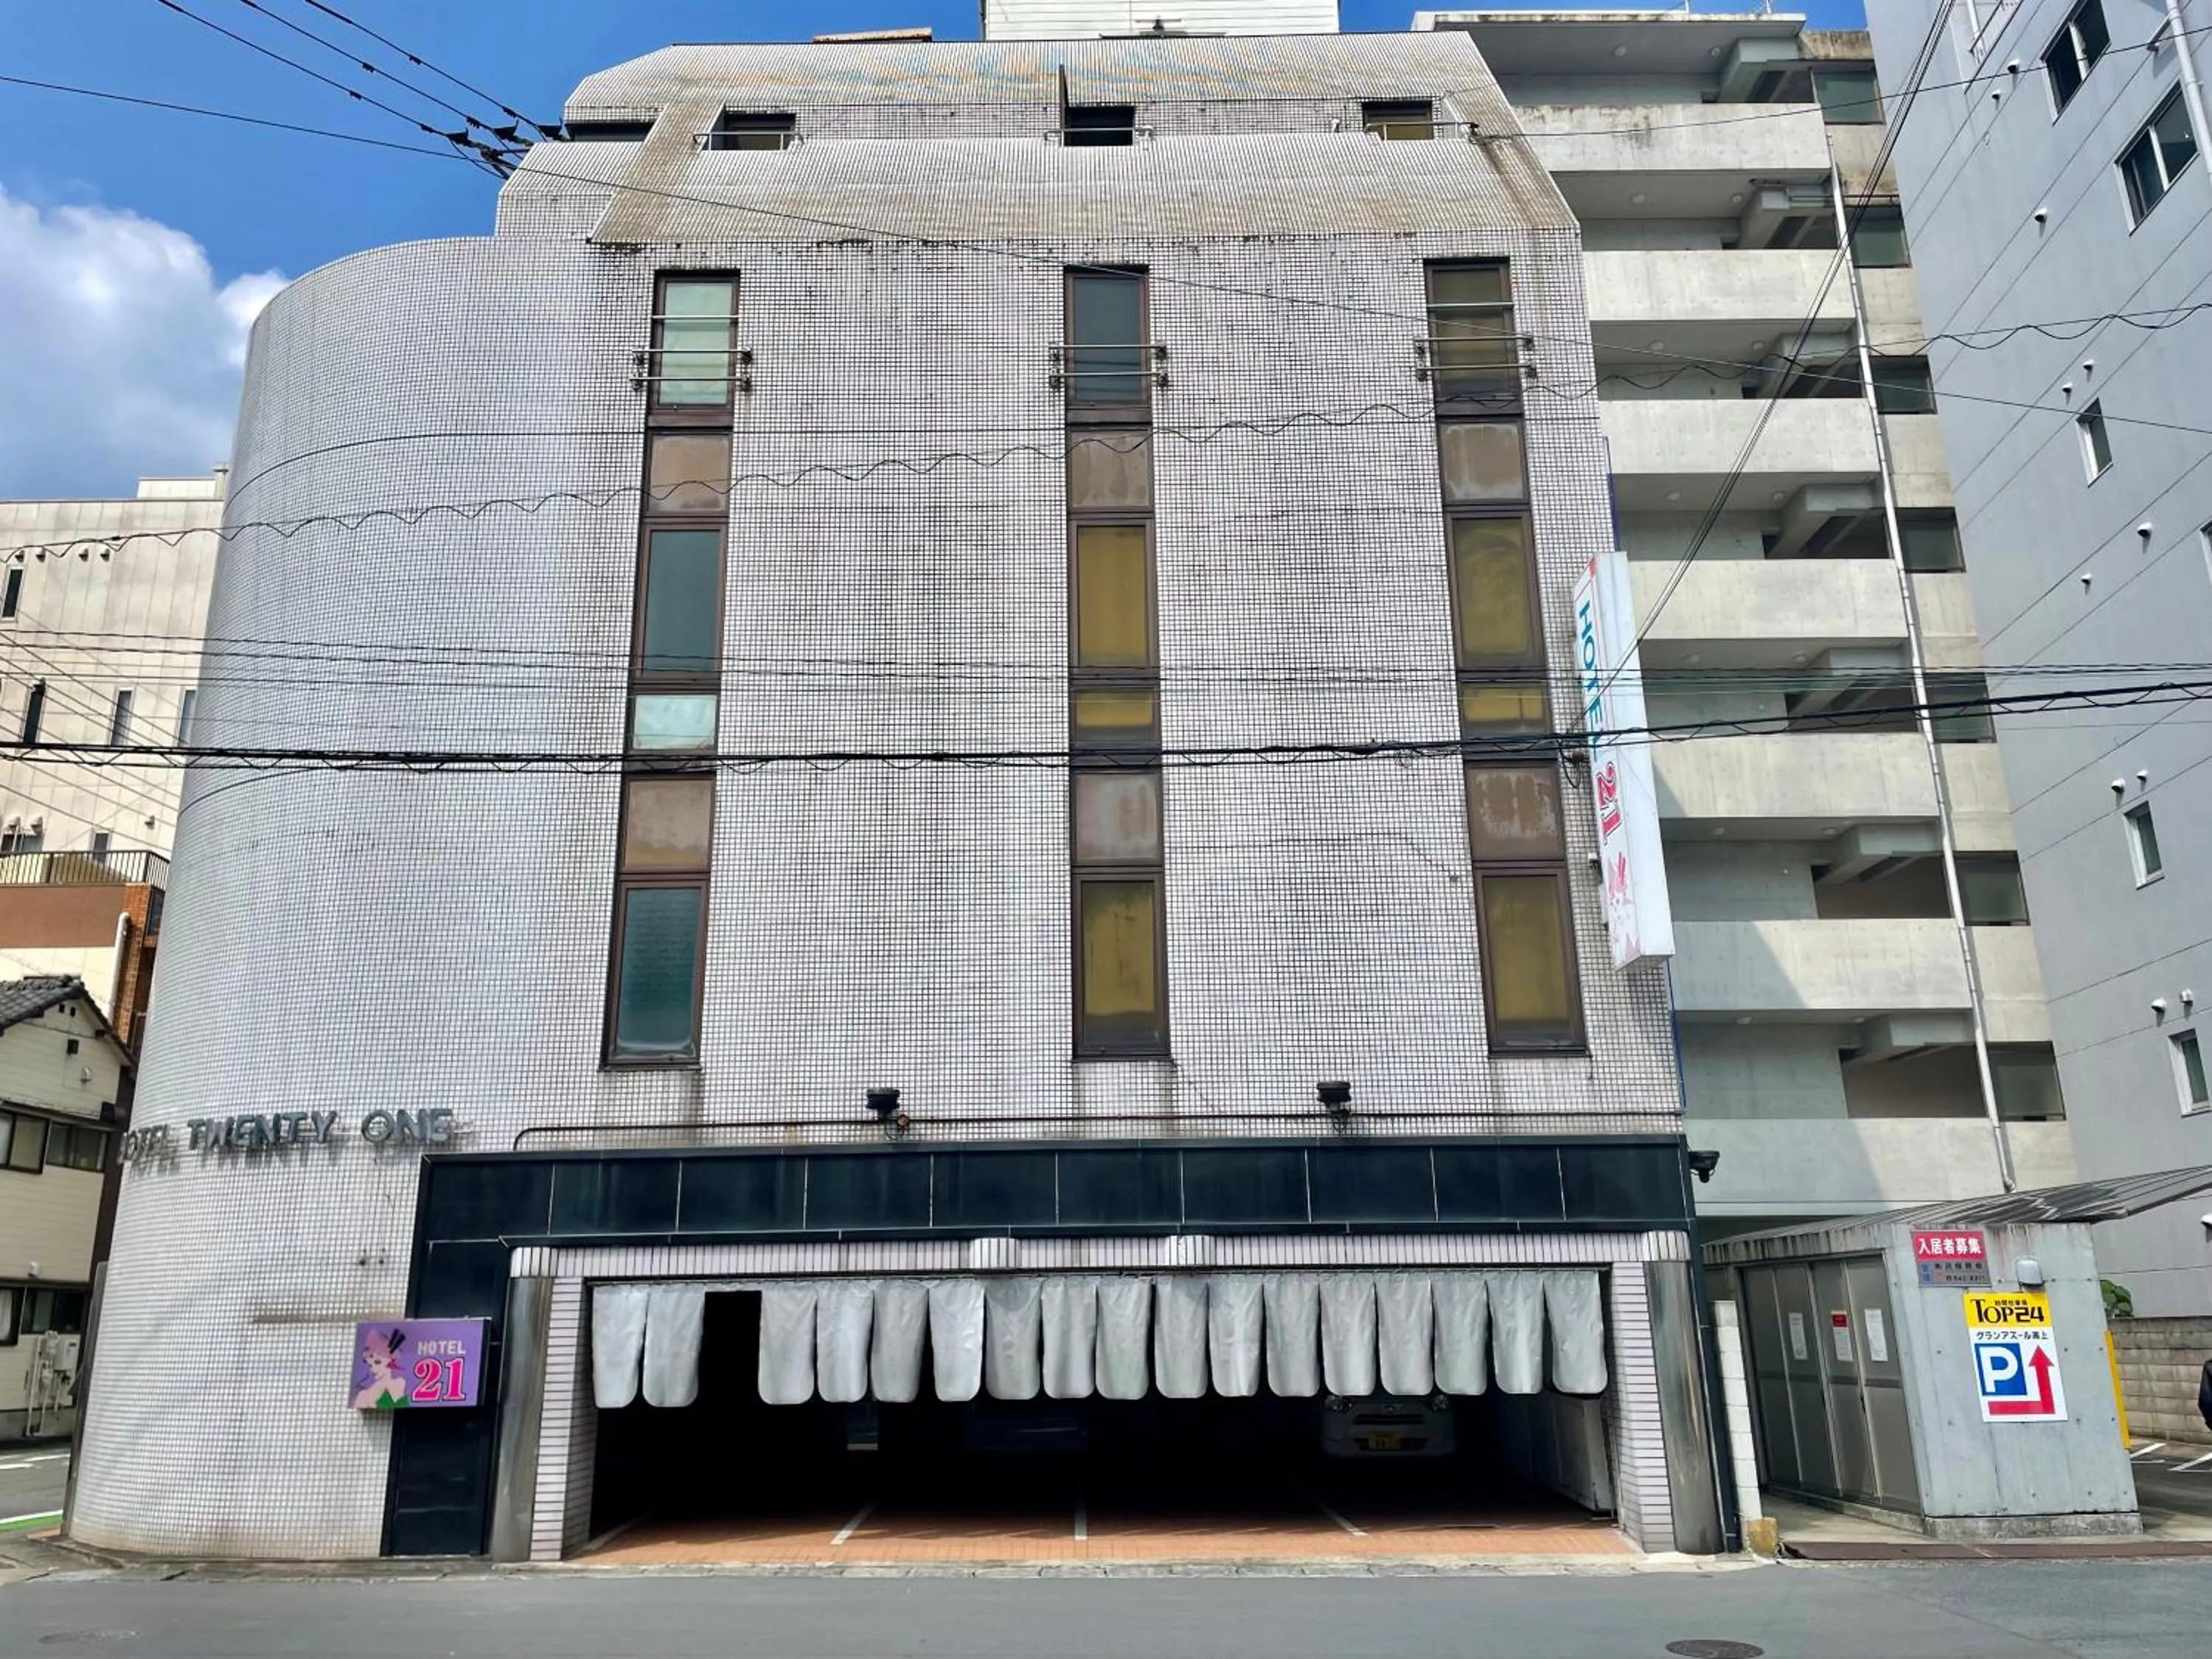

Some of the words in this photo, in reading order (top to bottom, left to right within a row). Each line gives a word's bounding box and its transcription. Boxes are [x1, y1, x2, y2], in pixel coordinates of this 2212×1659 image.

[1579, 599, 1603, 763] HOTEL
[1595, 760, 1623, 846] 21
[187, 1110, 337, 1150] TWENTY
[361, 1108, 453, 1143] ONE
[1919, 1237, 1981, 1255] 入居者募集
[417, 1340, 467, 1356] HOTEL
[1978, 1346, 2019, 1393] P
[412, 1357, 467, 1402] 21
